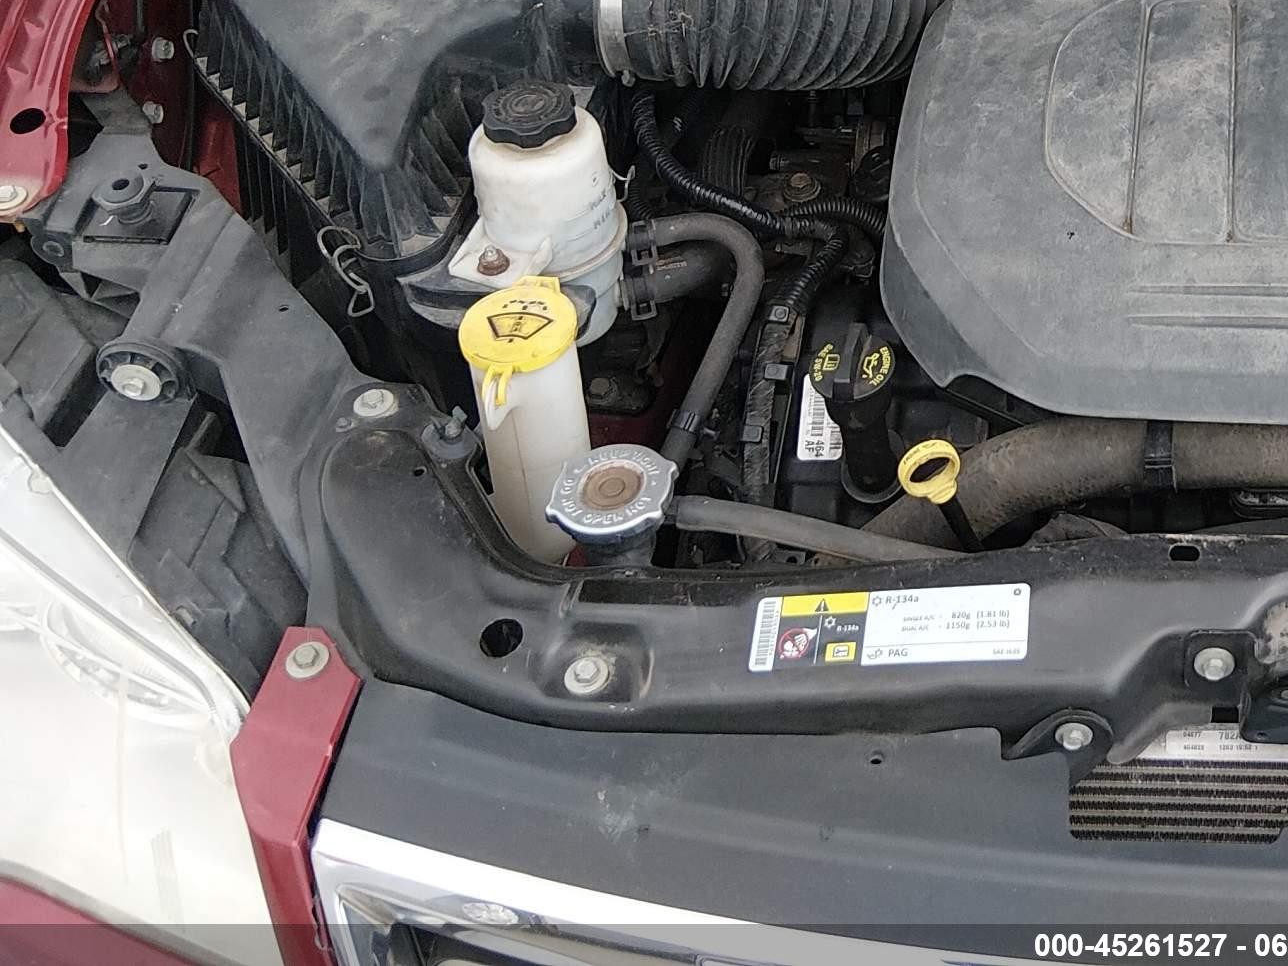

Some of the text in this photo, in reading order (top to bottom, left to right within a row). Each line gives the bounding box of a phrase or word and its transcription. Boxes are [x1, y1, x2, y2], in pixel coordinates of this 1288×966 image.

[814, 343, 834, 382] SAE 5W-20
[869, 346, 891, 386] ENGINE OIL
[885, 594, 919, 605] R-134a
[951, 612, 971, 621] 820g
[946, 621, 971, 631] 1150g
[888, 648, 909, 658] PAG
